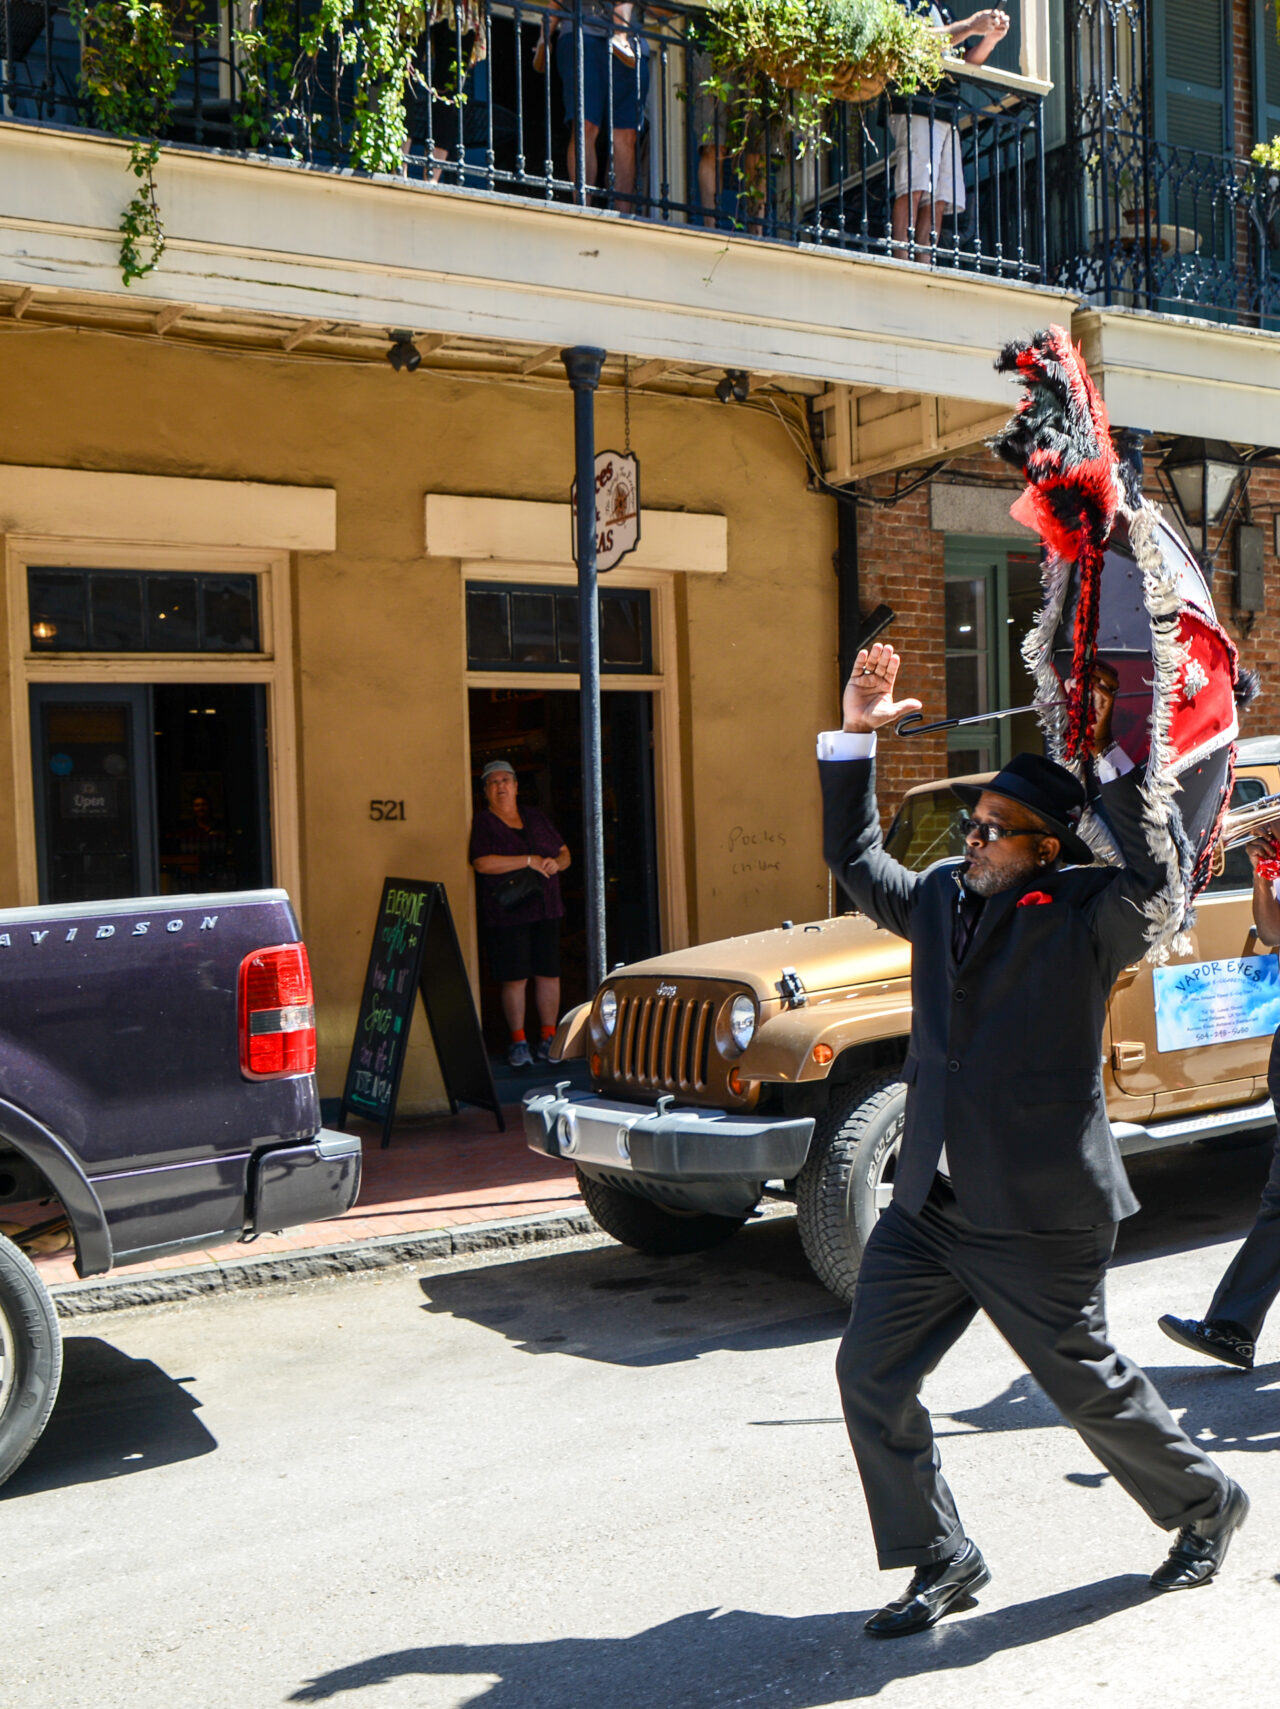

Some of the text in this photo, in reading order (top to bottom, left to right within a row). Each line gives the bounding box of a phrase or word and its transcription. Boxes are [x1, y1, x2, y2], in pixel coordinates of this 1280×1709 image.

[370, 799, 407, 822] 521
[0, 915, 218, 948] AVIDSON
[1175, 961, 1223, 992] VAPOR
[1227, 960, 1263, 982] EYES
